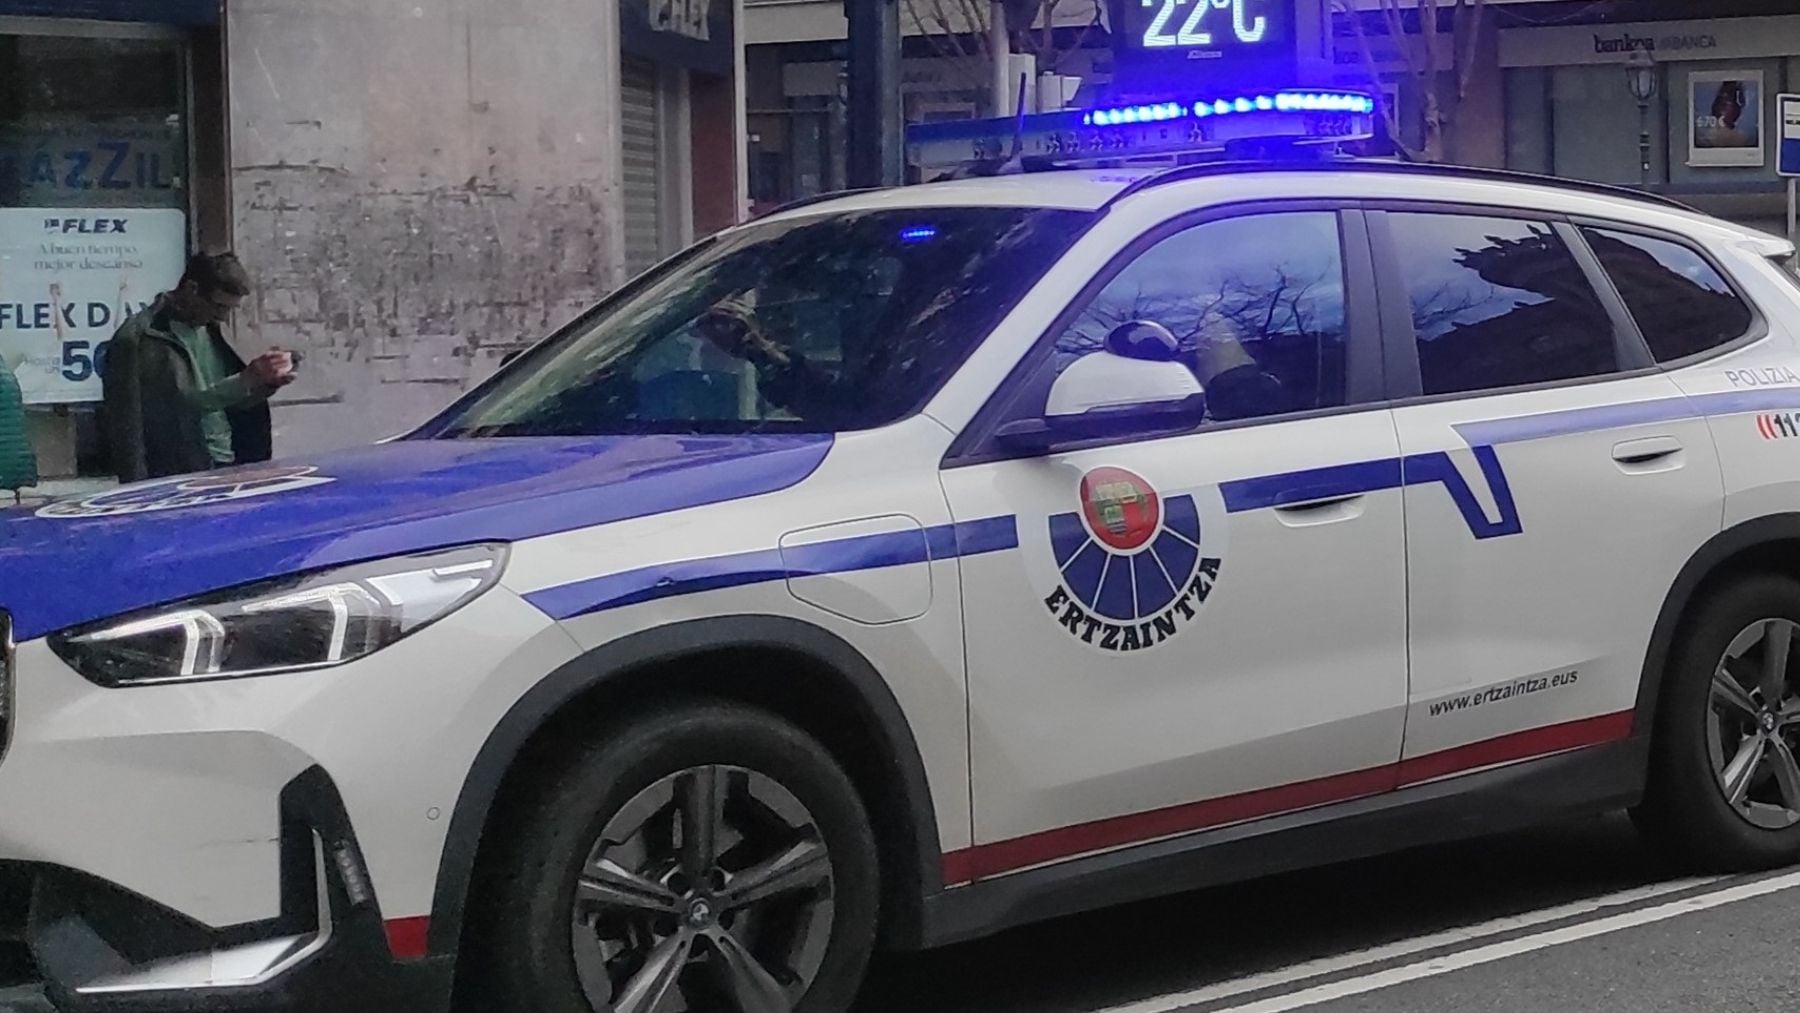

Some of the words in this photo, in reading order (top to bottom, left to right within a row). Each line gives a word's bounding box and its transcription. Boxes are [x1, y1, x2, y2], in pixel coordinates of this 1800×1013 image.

[62, 219, 128, 234] FLEX
[0, 302, 76, 329] FLEX
[1774, 413, 1800, 437] 11
[1044, 557, 1221, 651] ERTZAINTZA
[1429, 670, 1578, 717] www.ertzaintza.eus
